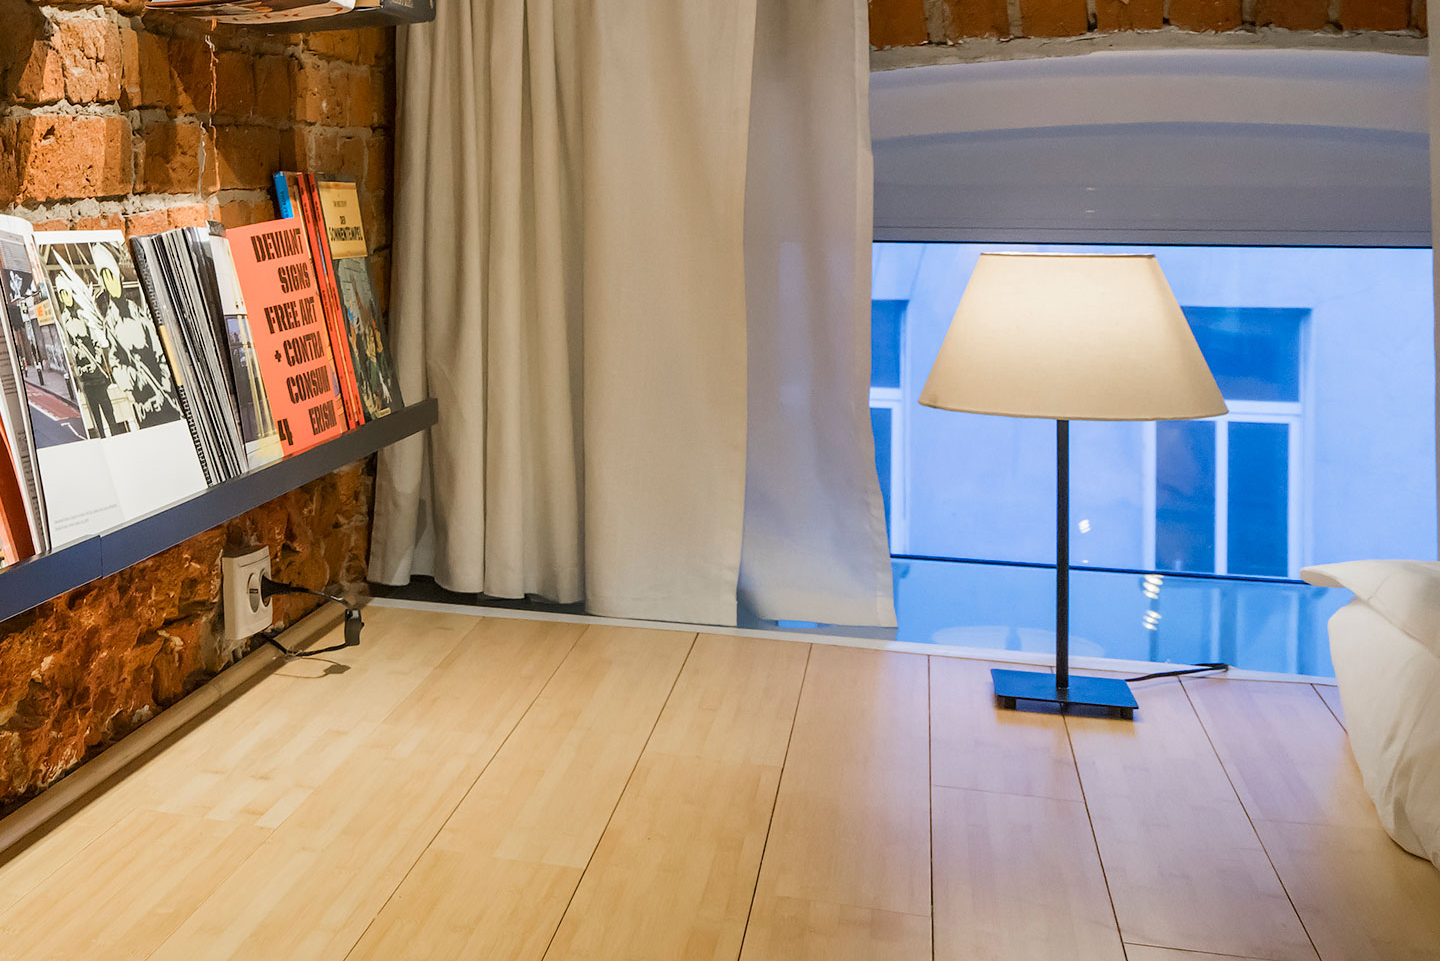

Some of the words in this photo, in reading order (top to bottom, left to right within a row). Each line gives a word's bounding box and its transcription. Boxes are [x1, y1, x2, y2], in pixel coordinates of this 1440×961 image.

[250, 228, 304, 263] DEVIANT
[277, 262, 311, 294] SIGNS
[264, 302, 300, 335] FREE
[300, 296, 317, 327] ART
[283, 330, 325, 367] CONTRA
[286, 365, 331, 405] CONSUM
[308, 399, 337, 436] ERISM
